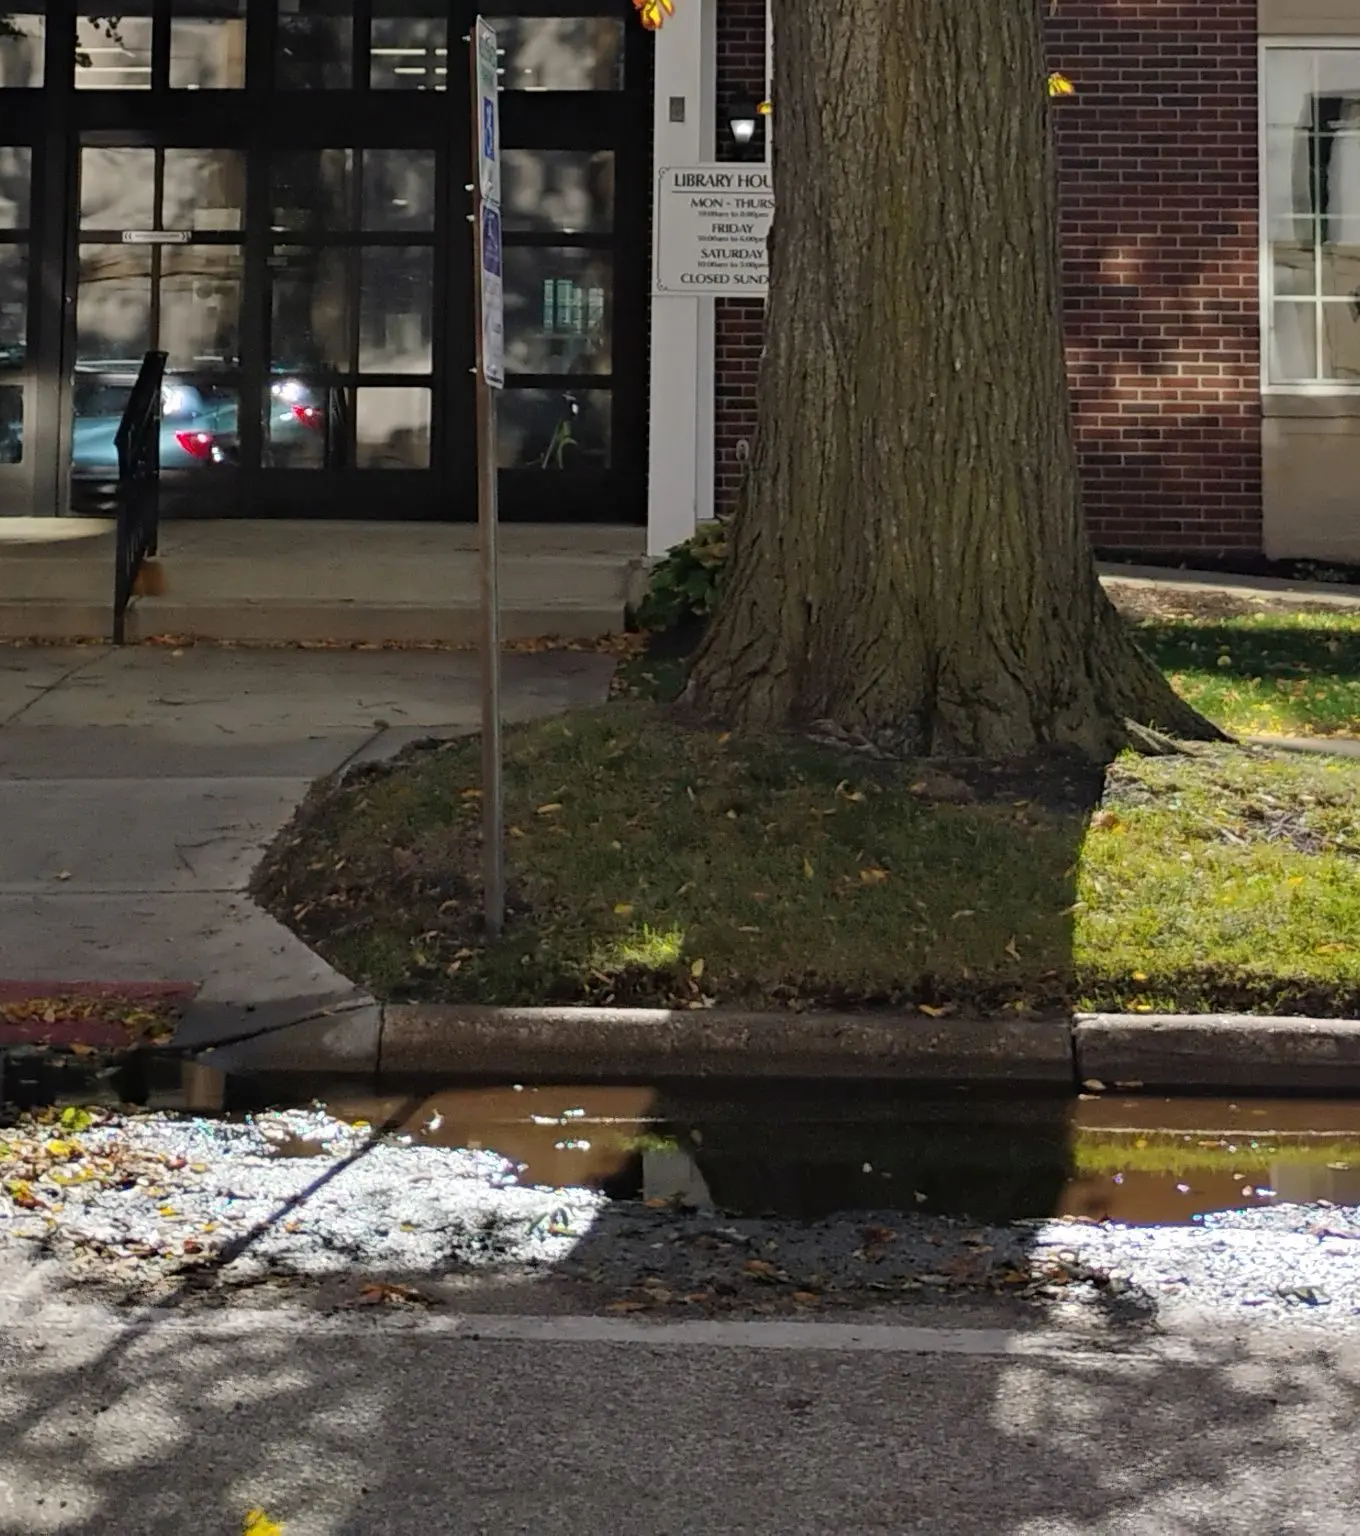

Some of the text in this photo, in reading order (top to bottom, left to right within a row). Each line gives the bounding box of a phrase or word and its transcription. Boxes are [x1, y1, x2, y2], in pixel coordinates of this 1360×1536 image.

[674, 173, 773, 188] LIBRARY HOU
[690, 197, 723, 209] MON
[712, 223, 755, 234] FRIDAY
[701, 248, 764, 260] SATURDAY
[680, 273, 772, 284] CLOSED SUND
